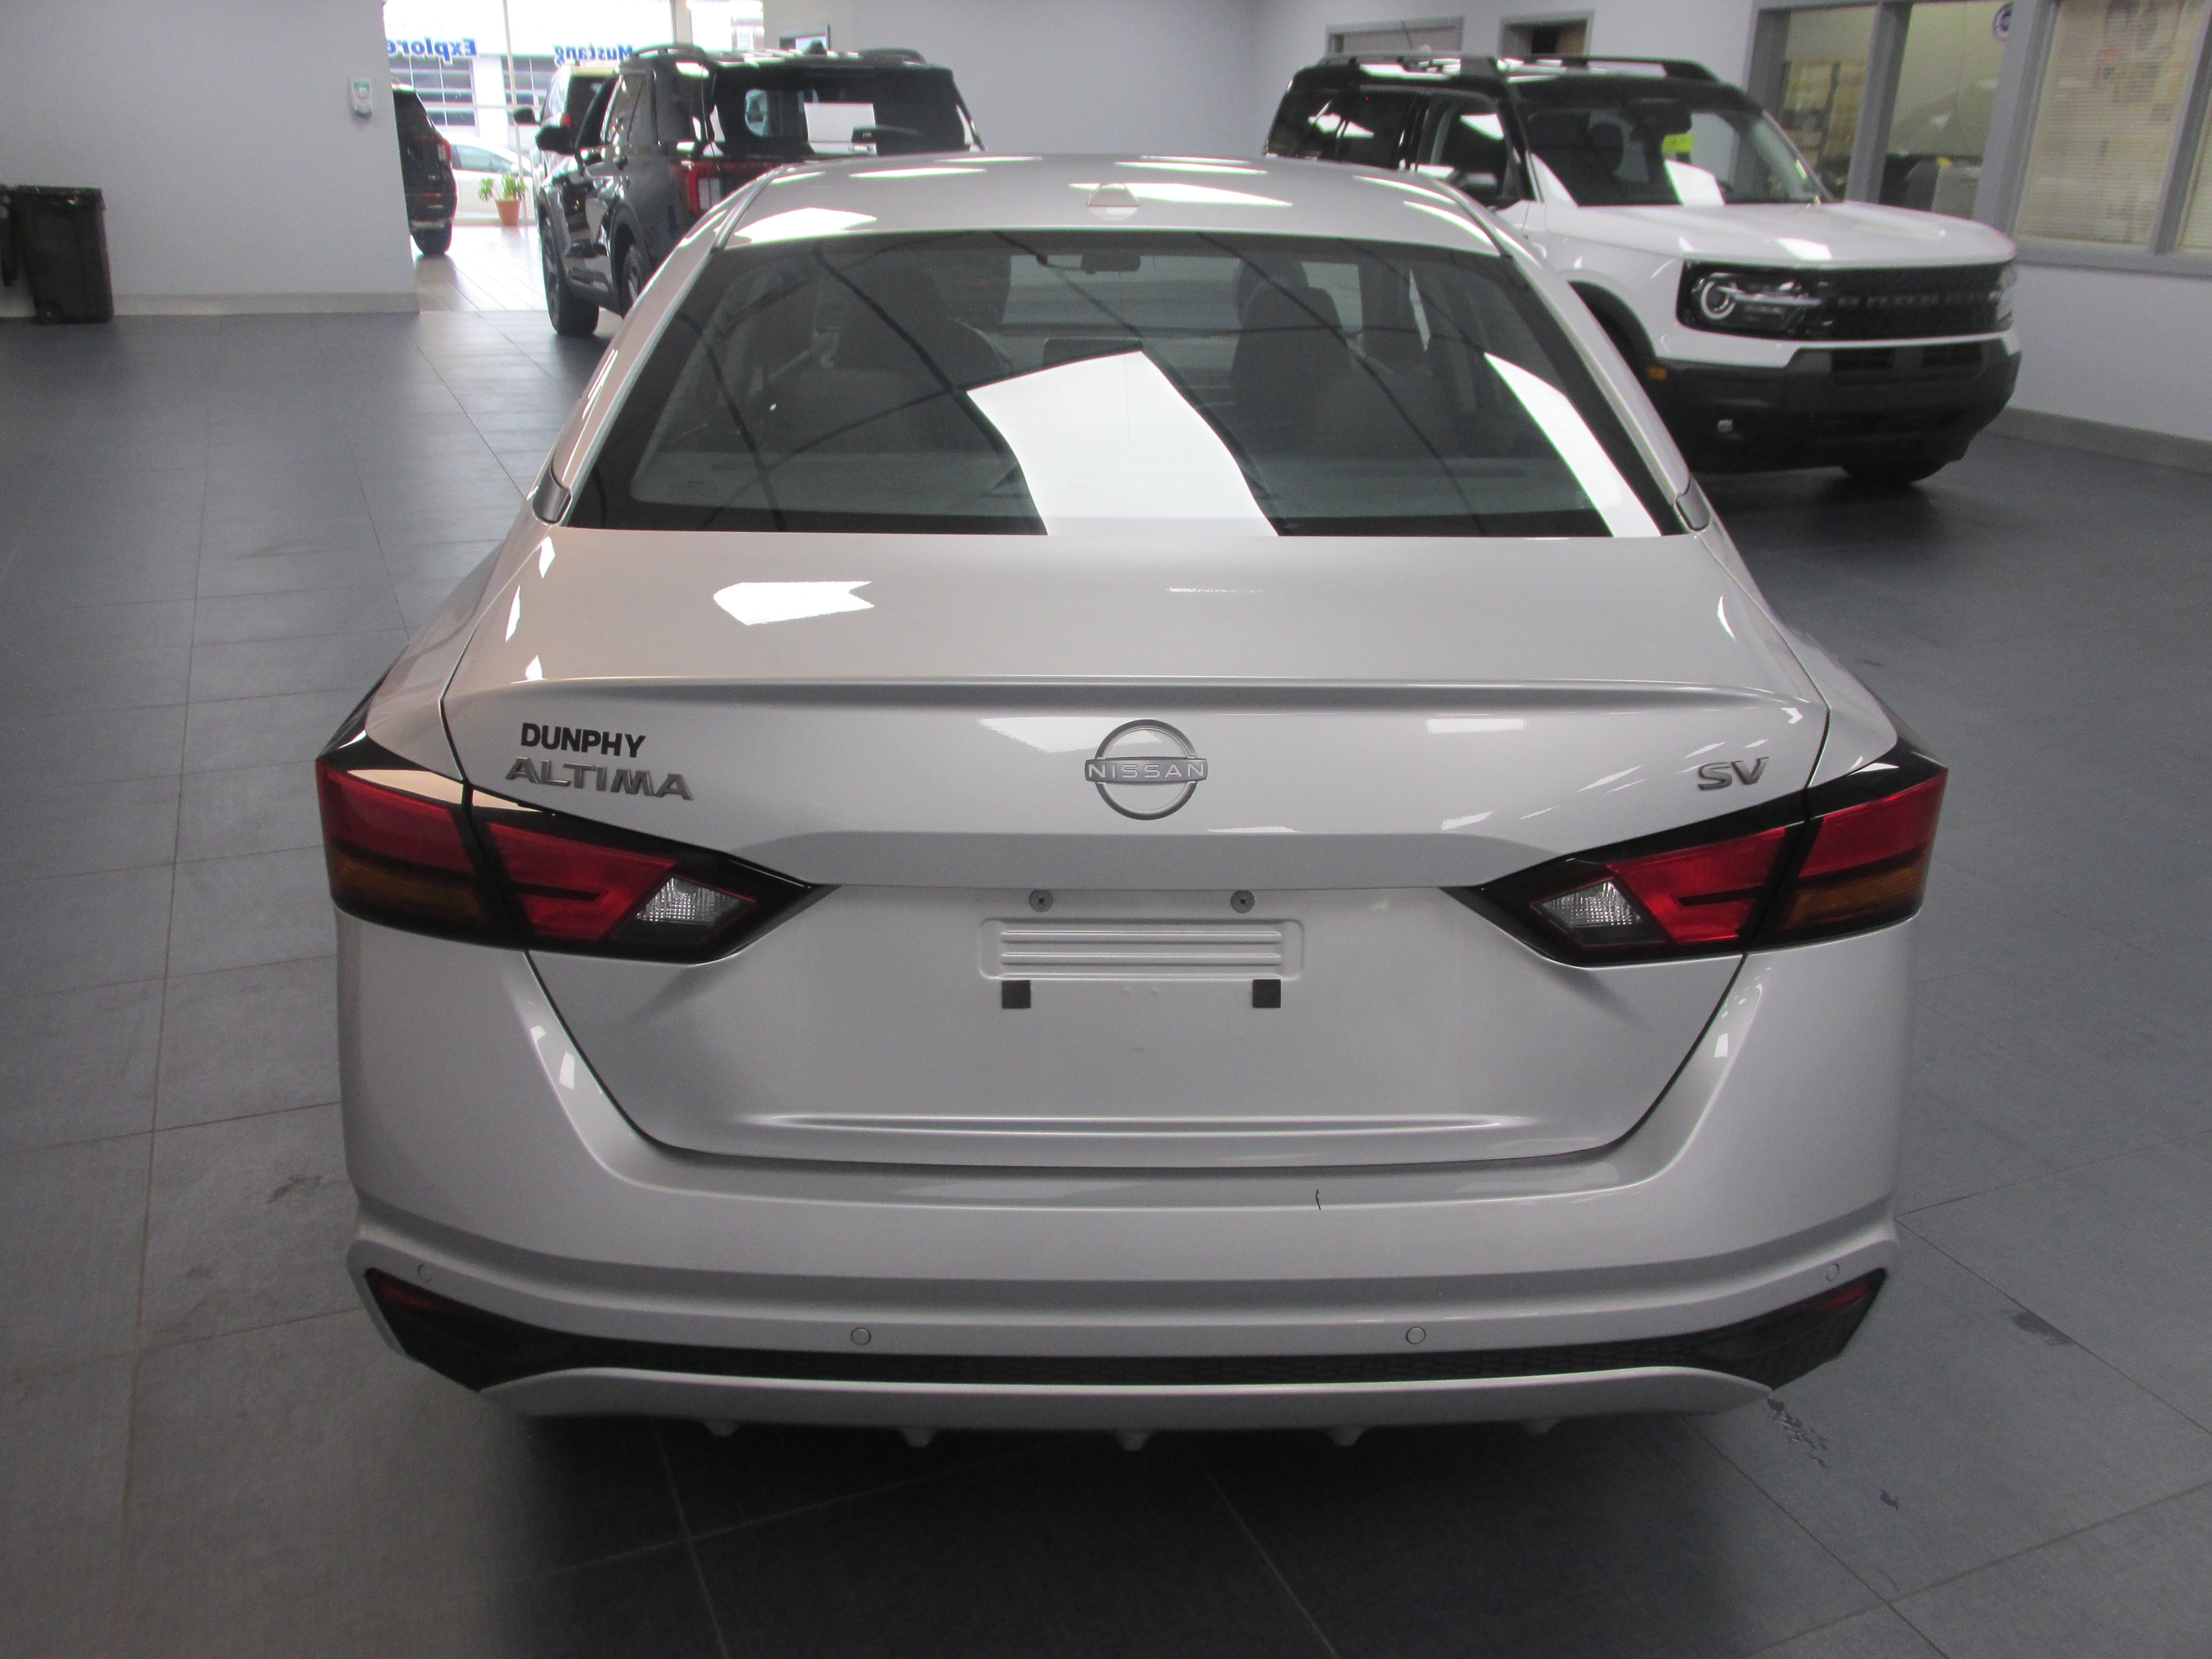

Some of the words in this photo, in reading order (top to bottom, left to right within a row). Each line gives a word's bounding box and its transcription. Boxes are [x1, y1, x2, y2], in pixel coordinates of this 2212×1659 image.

[520, 722, 646, 758] DUNPHY
[505, 757, 694, 801] ALTIMA
[1088, 763, 1204, 778] NISSAN
[1697, 757, 1769, 790] SV
